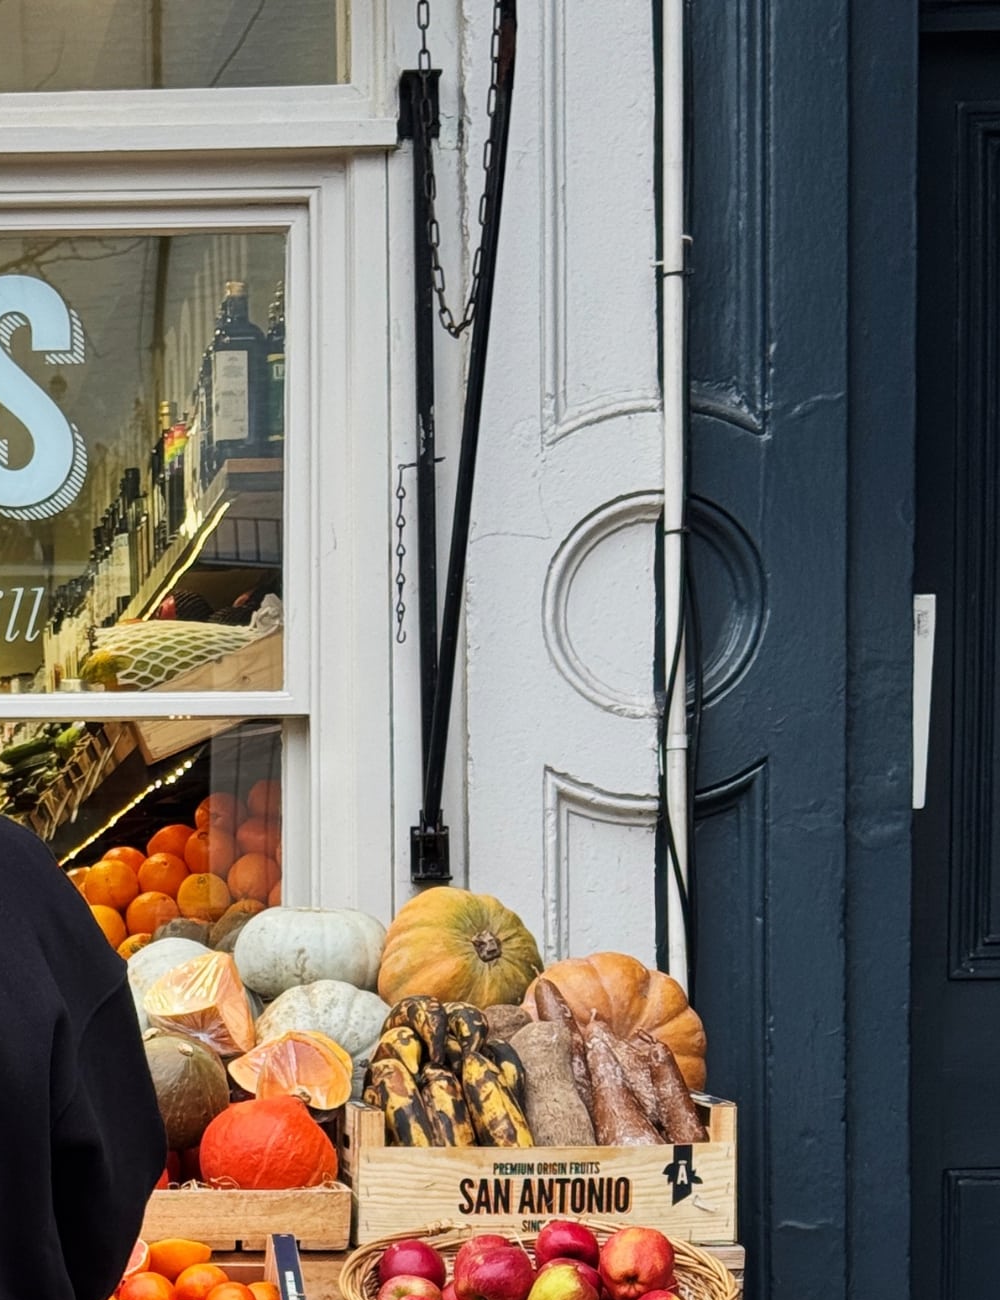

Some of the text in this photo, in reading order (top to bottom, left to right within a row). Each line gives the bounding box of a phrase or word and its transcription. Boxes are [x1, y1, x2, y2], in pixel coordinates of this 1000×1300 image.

[493, 1161, 600, 1176] PREMIUM ORIGIN FRUITS
[458, 1177, 632, 1215] SAN ANTONIO
[521, 1219, 547, 1232] SINC
